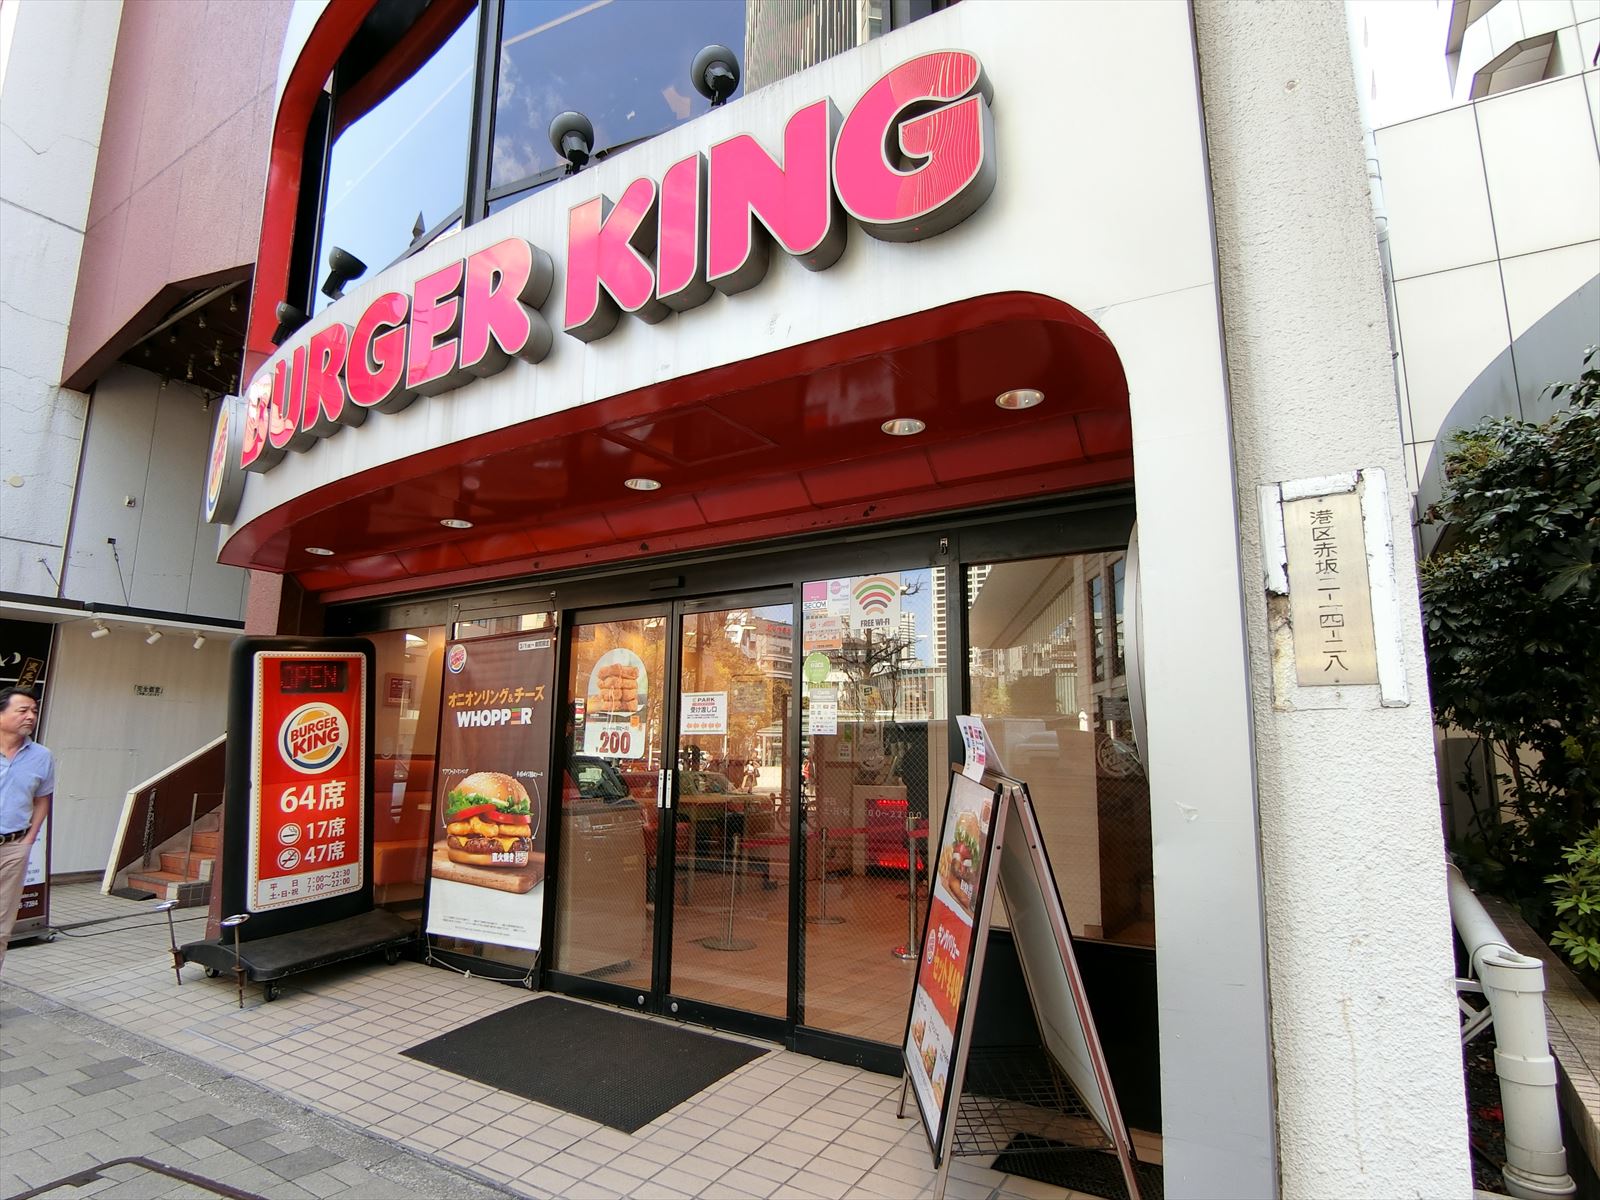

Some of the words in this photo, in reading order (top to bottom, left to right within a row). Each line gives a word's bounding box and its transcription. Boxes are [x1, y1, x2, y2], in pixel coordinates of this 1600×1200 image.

[240, 237, 543, 471] BURGER
[564, 48, 990, 336] KING
[861, 619, 874, 627] FREE
[876, 618, 890, 626] WI-FI
[280, 665, 337, 689] OPEN
[448, 684, 545, 708] オニオンリング&チーズ
[290, 716, 338, 742] BURGER
[292, 726, 340, 758] KING
[280, 780, 346, 813] 64席
[306, 817, 346, 840] 17席
[304, 841, 346, 863] 47席
